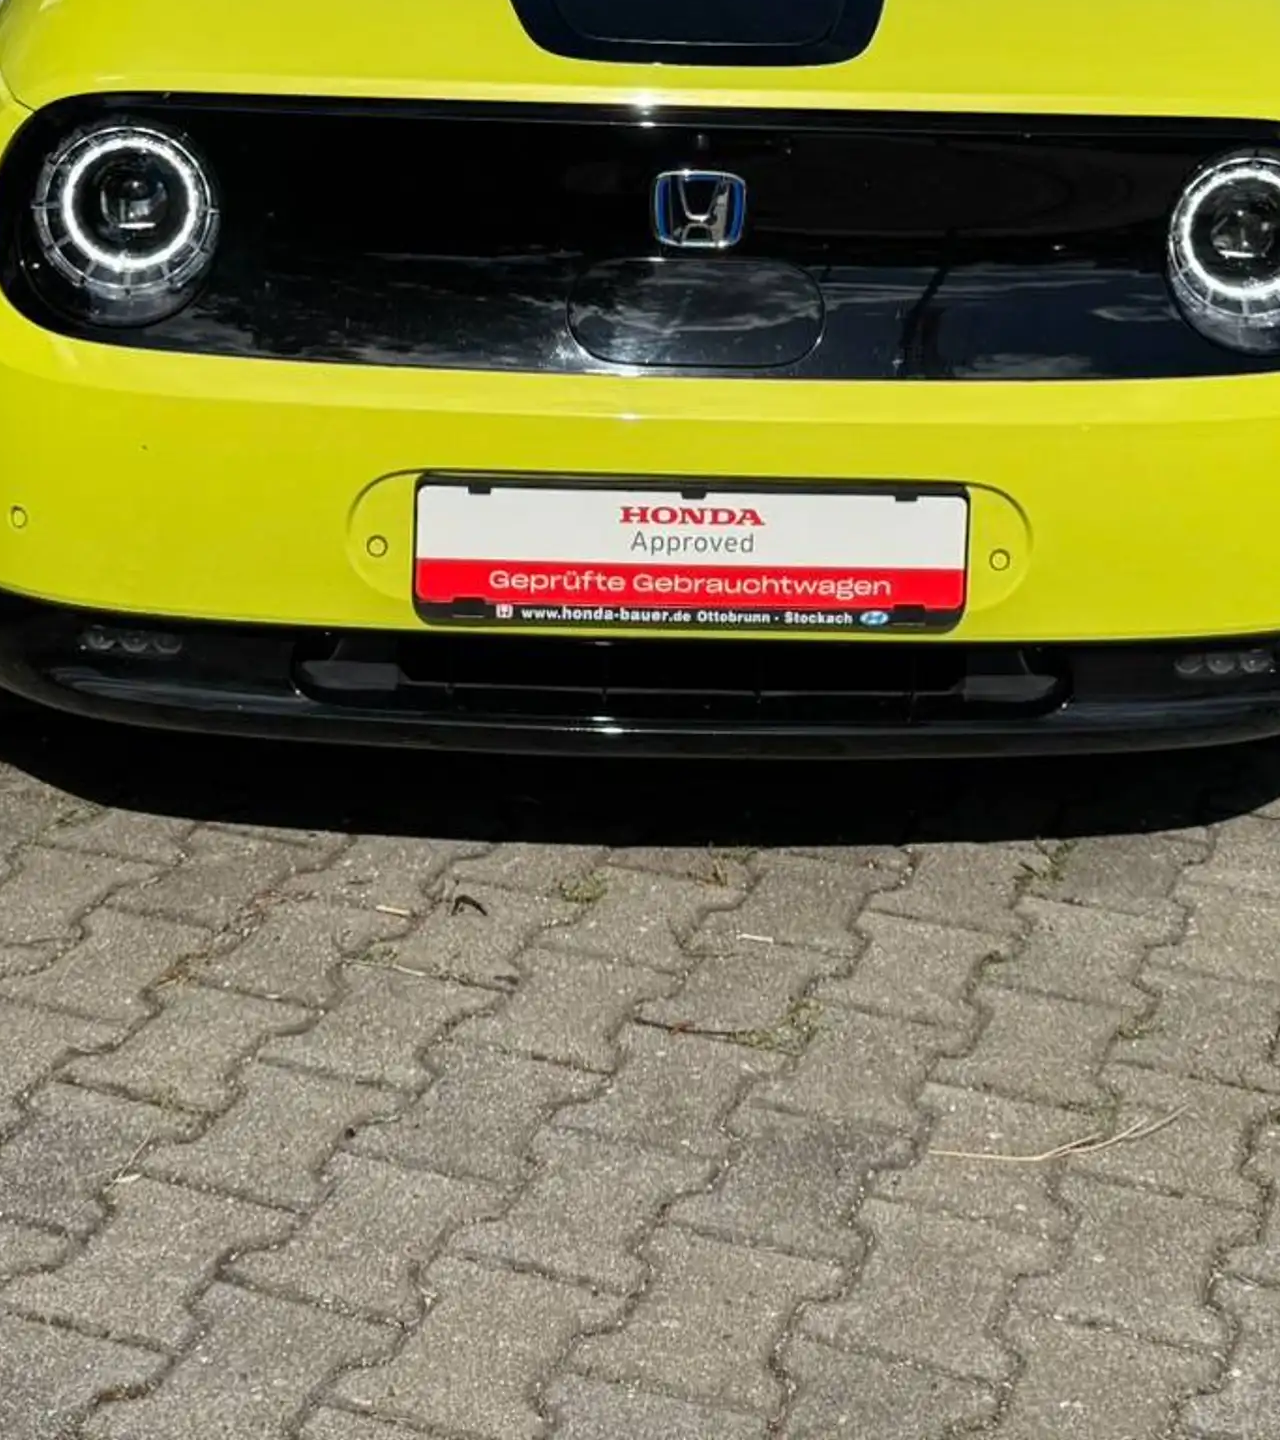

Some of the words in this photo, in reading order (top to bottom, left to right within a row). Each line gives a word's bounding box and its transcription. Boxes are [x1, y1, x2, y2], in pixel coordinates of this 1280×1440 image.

[619, 505, 767, 527] HONDA
[630, 529, 756, 557] Approved
[488, 568, 626, 594] Geprüfte
[632, 571, 892, 601] Gebrauchtwagen
[520, 605, 692, 623] www.honda-bauer.de
[697, 609, 771, 624] Ottobrunn
[784, 611, 853, 625] Stockach
